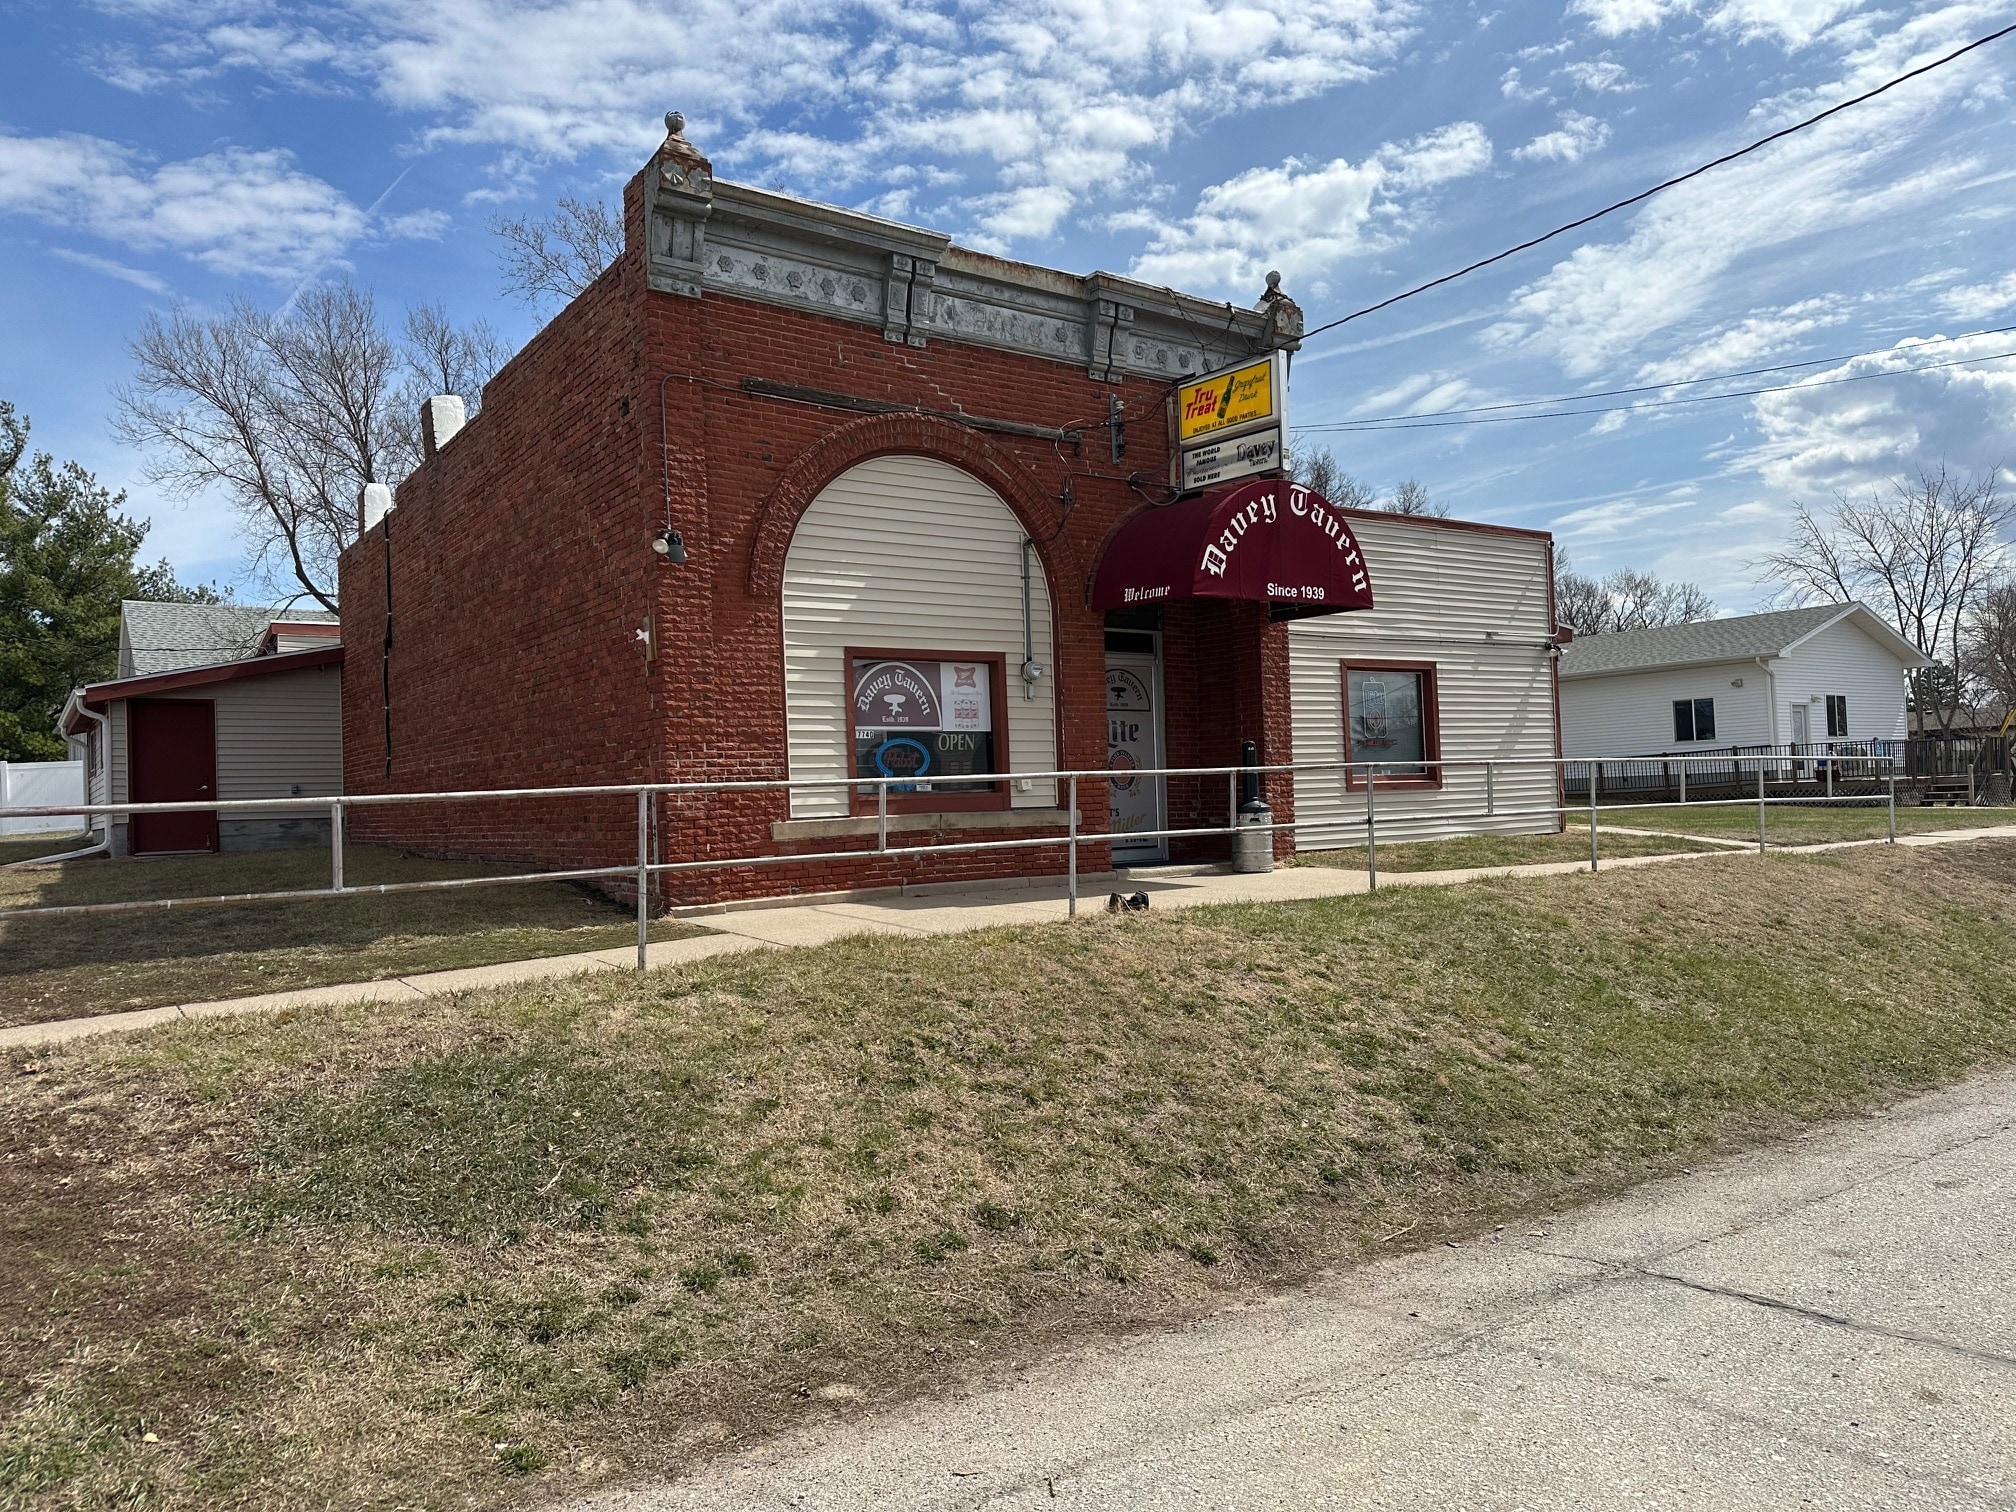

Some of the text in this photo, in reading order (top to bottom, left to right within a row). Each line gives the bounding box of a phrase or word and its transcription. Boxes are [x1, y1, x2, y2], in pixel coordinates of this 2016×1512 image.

[1194, 388, 1214, 405] Tru
[1185, 396, 1217, 420] Treat
[1193, 424, 1210, 434] ENJOYED
[1218, 418, 1226, 426] ALL
[1226, 416, 1238, 425] GOOD
[1192, 447, 1220, 459] THE WORLD
[1236, 440, 1275, 462] Davey
[1196, 455, 1216, 466] FAMOUS
[1248, 457, 1268, 467] Tavern
[1194, 472, 1220, 483] SOLD HERE
[1200, 483, 1368, 593] Davey Tavern
[1123, 584, 1171, 603] Welcome
[1267, 582, 1325, 600] Since 1939
[857, 669, 930, 715] Davey Tavern
[1118, 671, 1143, 701] Tavern
[938, 734, 975, 751] OPEN
[886, 750, 920, 768] Pabst
